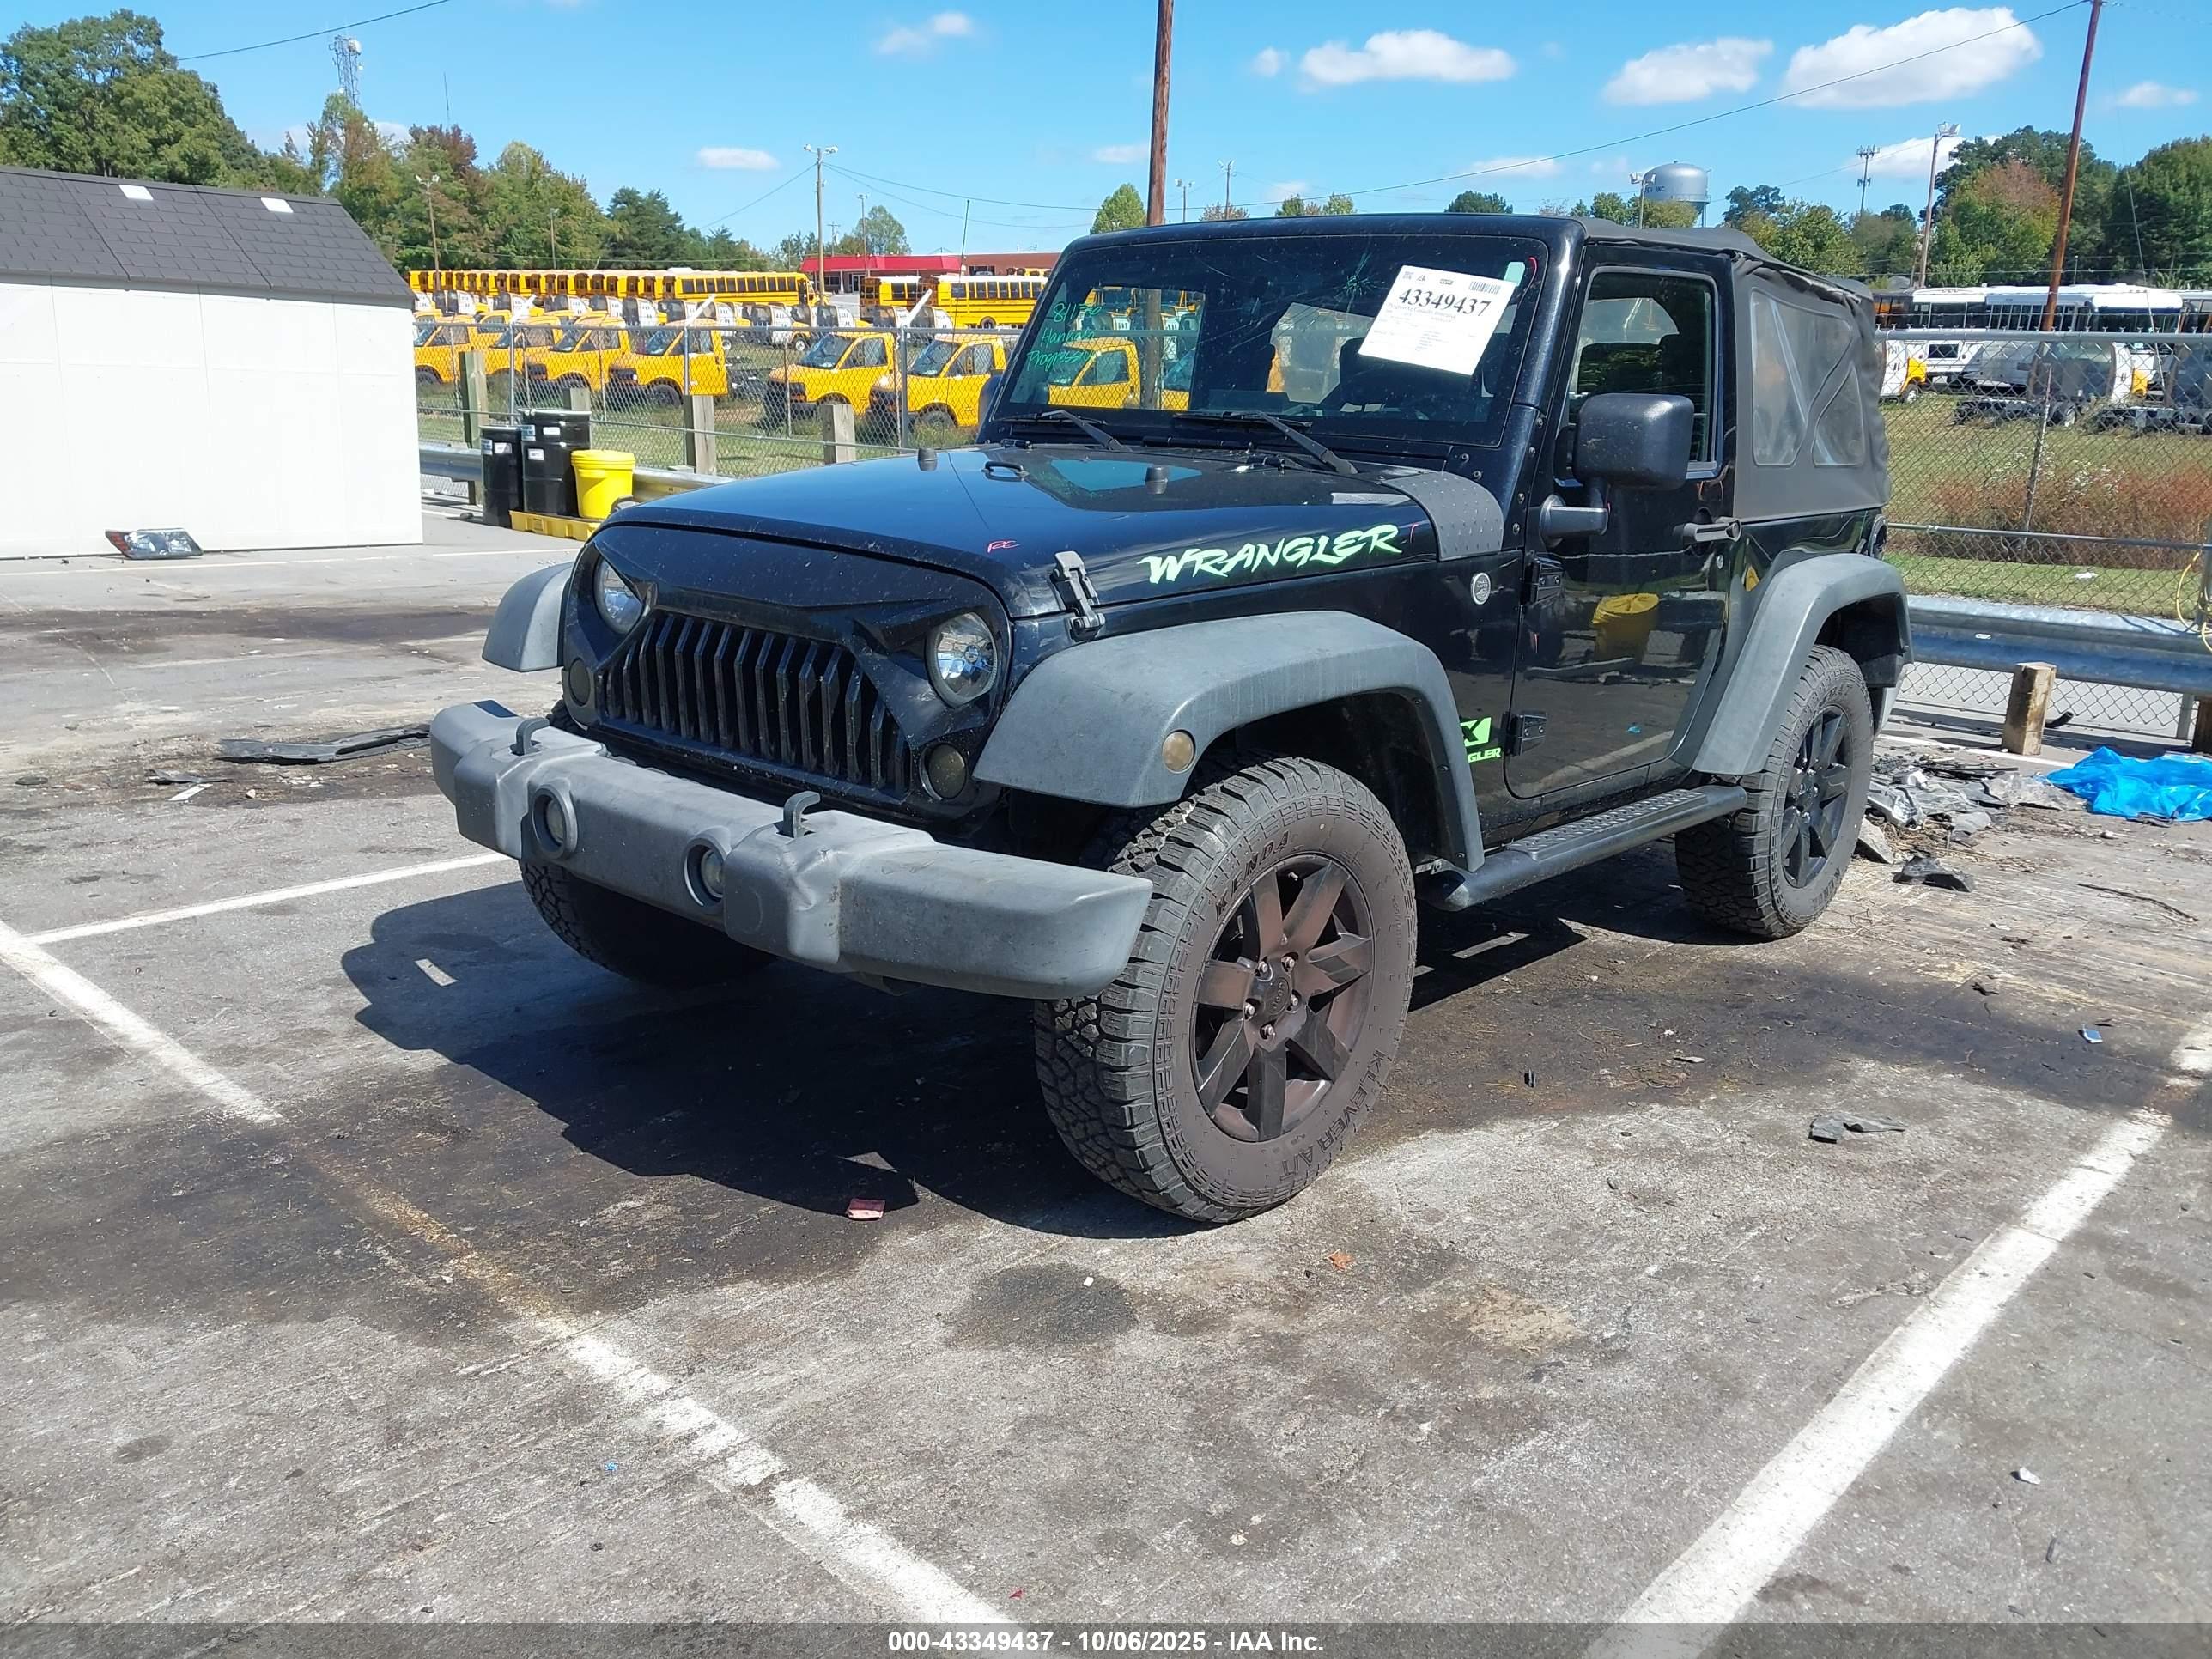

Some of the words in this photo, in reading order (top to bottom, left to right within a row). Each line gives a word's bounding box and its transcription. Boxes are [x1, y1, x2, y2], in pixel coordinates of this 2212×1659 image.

[1399, 288, 1492, 316] 43349437
[1026, 349, 1096, 372] Progressiv
[1136, 524, 1403, 584] WRANGLER
[1467, 747, 1501, 763] GLER
[1215, 830, 1289, 921] KENDA
[1316, 1049, 1386, 1153] KLEVER
